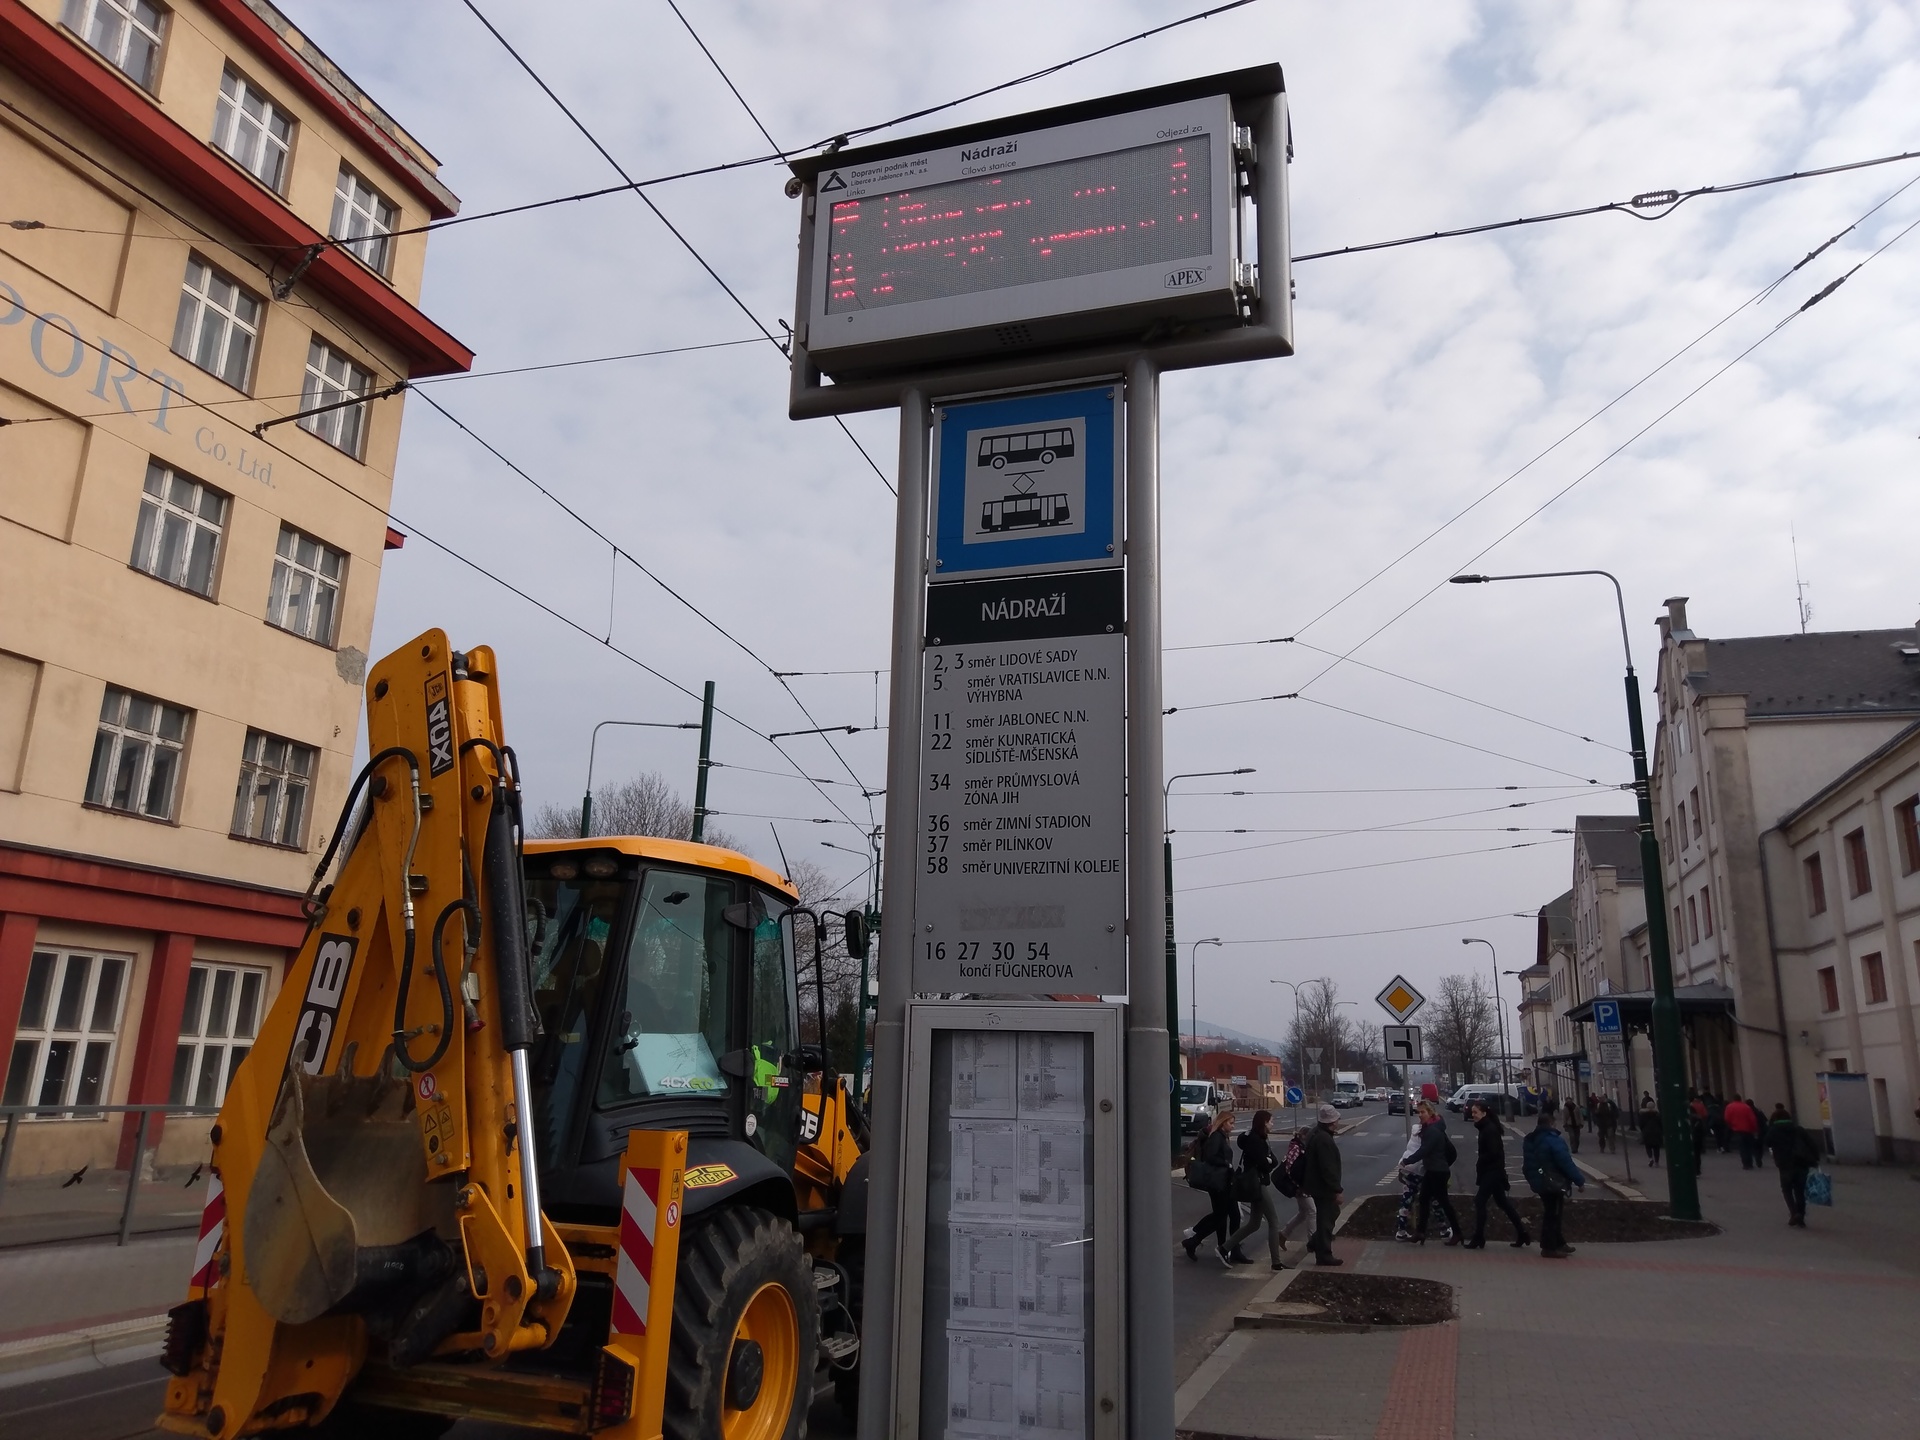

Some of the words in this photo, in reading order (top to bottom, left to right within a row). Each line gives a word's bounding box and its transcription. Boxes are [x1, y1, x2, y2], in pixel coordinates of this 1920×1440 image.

[1156, 125, 1189, 139] Odjezd
[1191, 125, 1203, 133] za
[961, 140, 1018, 162] Nádraží
[851, 166, 883, 179] Dopravní
[884, 162, 909, 174] podnik
[910, 158, 928, 168] měst
[961, 165, 987, 176] Cílová
[988, 160, 1017, 172] stanice
[850, 177, 871, 187] Liberce
[877, 172, 904, 182] Jablonce
[846, 187, 866, 198] Linka
[1167, 270, 1204, 287] APEX
[195, 426, 232, 467] Co.
[236, 447, 278, 490] Ltd.
[981, 592, 1067, 621] NÁDRAŽÍ
[933, 654, 949, 673] 2,
[954, 653, 964, 669] 3
[967, 655, 996, 669] směr
[999, 650, 1043, 667] LIDOVÉ
[1045, 649, 1078, 664] SADY
[933, 674, 943, 690] 5
[967, 676, 996, 689] směr
[999, 669, 1080, 687] VRATISLAVICE
[1084, 668, 1110, 681] N.N.
[967, 688, 1023, 703] VÝHYBNA
[933, 713, 950, 730] 11
[966, 716, 995, 729] směr
[998, 711, 1060, 727] JABLONEC
[1063, 710, 1089, 723] N.N.
[429, 700, 453, 769] 4CX
[931, 733, 952, 750] 22
[965, 736, 994, 749] směr
[998, 729, 1076, 746] KUNRATICKÁ
[965, 745, 1079, 764] SÍDLIŠTĚ-MŠENSKÁ
[929, 773, 951, 791] 34
[964, 777, 994, 790] směr
[997, 770, 1080, 788] PRŮMYSLOVÁ
[964, 790, 998, 805] ZÓNA
[1001, 791, 1019, 804] JIH
[927, 814, 950, 832] 36
[963, 818, 992, 831] směr
[995, 814, 1031, 830] ZIMNÍ
[1034, 815, 1091, 829] STADION
[927, 835, 949, 853] 37
[962, 839, 992, 852] směr
[995, 836, 1053, 851] PILÍNKOV
[926, 856, 948, 874] 58
[962, 860, 991, 873] směr
[993, 858, 1070, 875] UNIVERZITNÍ
[1074, 859, 1120, 873] KOLEJE
[925, 942, 946, 960] 16
[957, 942, 980, 960] 27
[992, 942, 1015, 960] 30
[1027, 942, 1050, 960] 54
[959, 963, 991, 978] končí
[995, 962, 1073, 978] FÜGNEROVA
[290, 940, 352, 1076] CB
[1599, 1005, 1613, 1023] P
